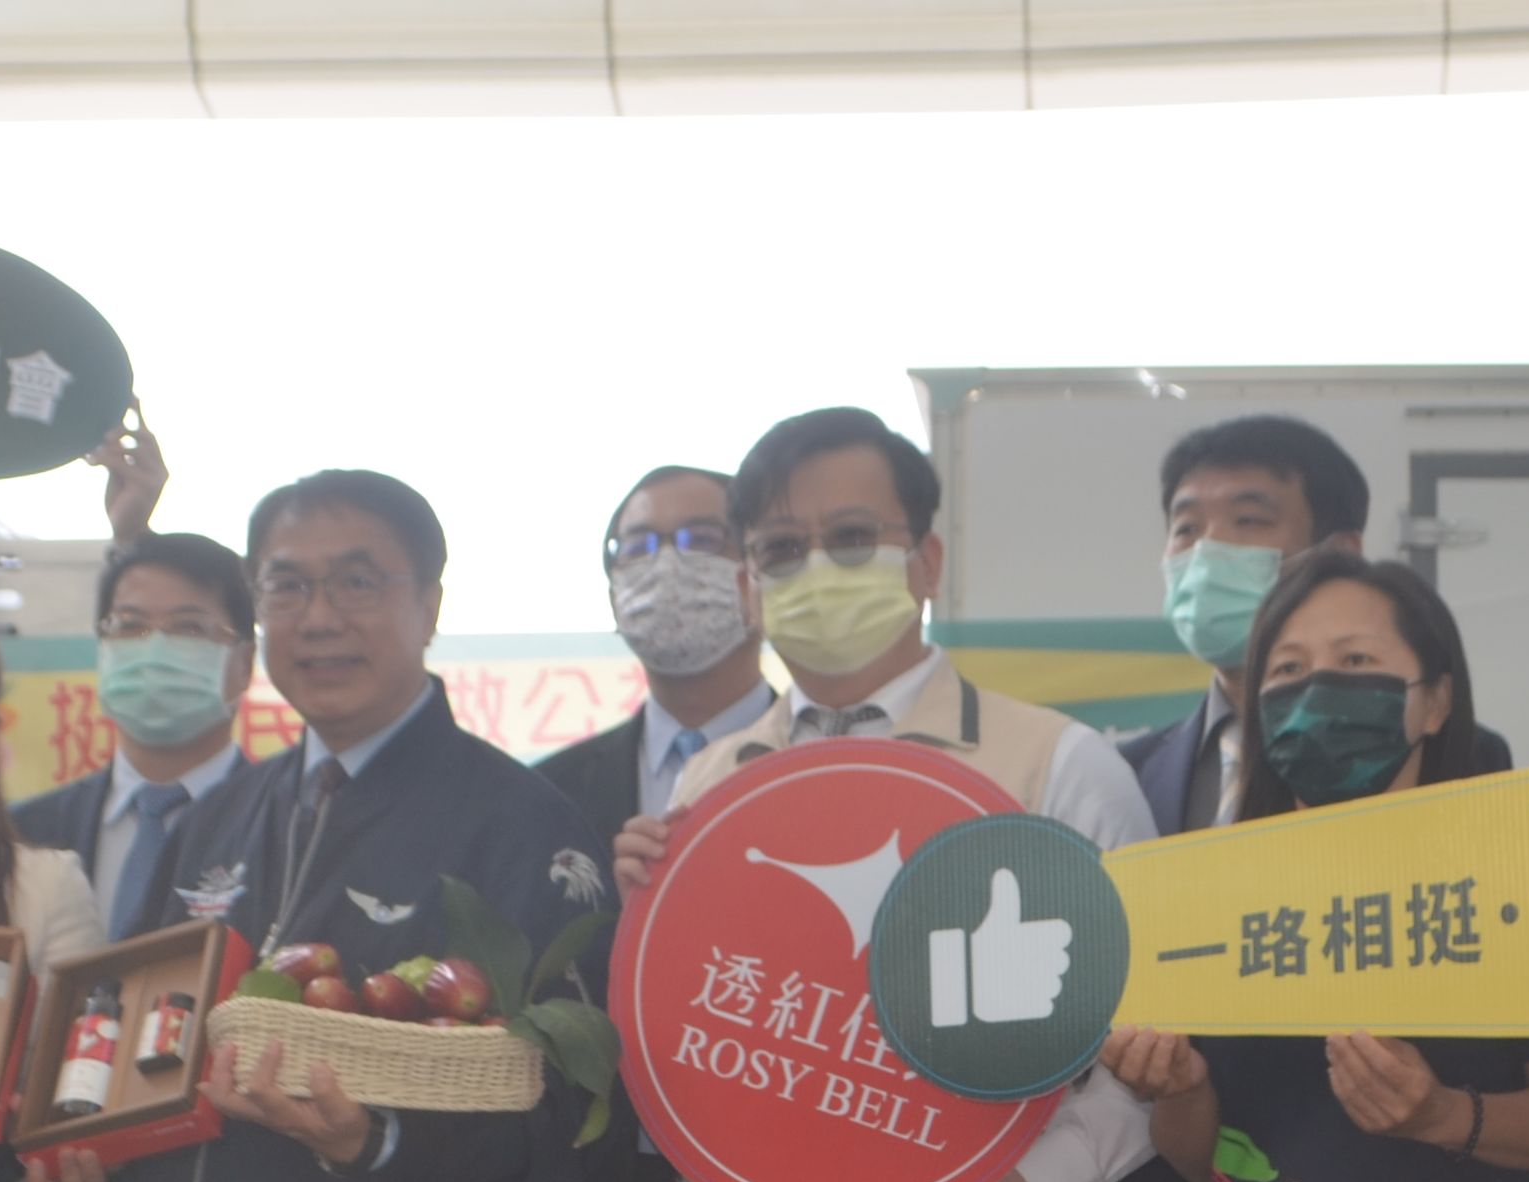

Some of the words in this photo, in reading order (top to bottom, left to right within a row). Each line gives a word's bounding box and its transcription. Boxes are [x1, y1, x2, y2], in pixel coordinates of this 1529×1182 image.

[690, 946, 920, 1080] 透紅佳
[672, 1023, 817, 1101] ROSY
[816, 1073, 947, 1151] BELL
